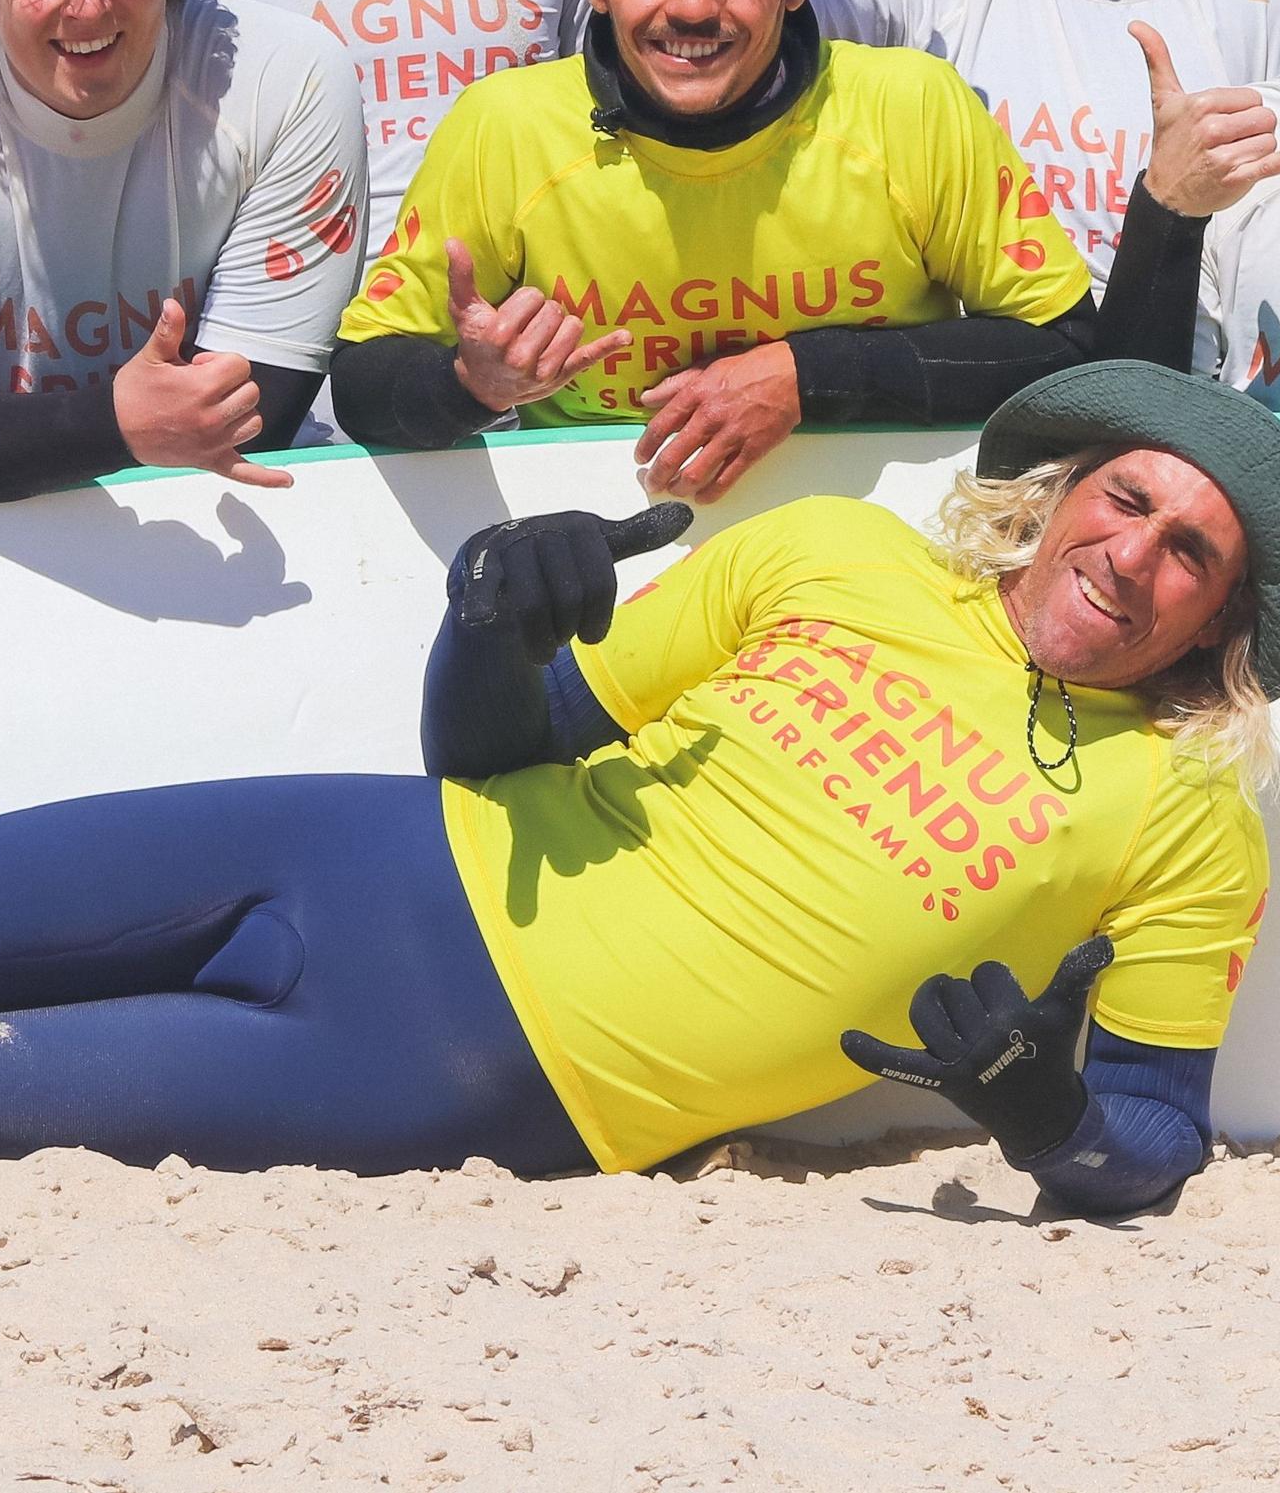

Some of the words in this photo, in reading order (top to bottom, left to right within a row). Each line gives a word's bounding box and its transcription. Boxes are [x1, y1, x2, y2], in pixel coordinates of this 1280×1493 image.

[551, 259, 886, 327] MAGNUS
[774, 613, 1068, 846] MAGNUS
[729, 686, 933, 879] SURFCAMP
[880, 1067, 926, 1085] SUPRATEX
[923, 1078, 942, 1088] 3.0
[978, 1040, 1025, 1085] SCUBAMAX
